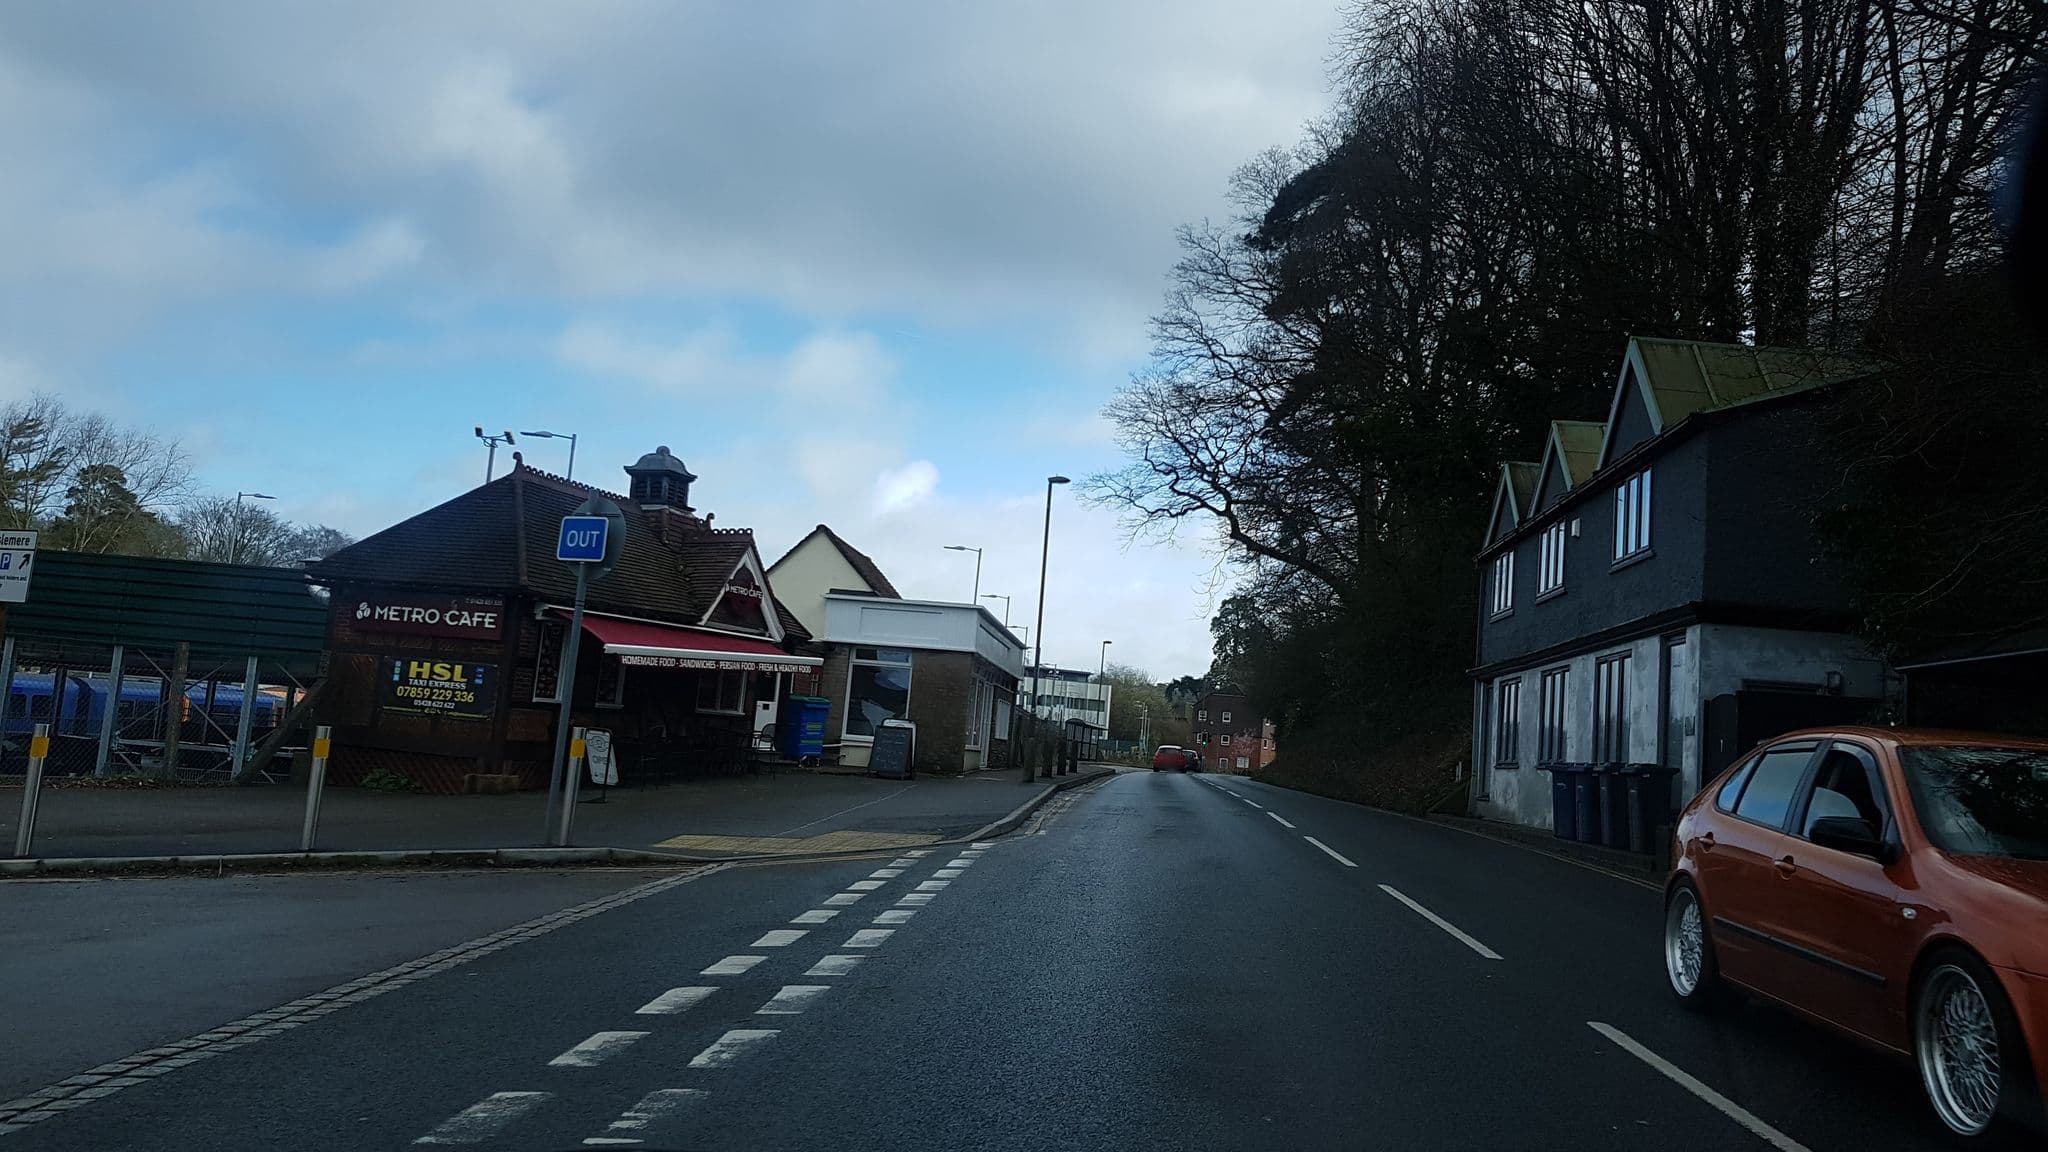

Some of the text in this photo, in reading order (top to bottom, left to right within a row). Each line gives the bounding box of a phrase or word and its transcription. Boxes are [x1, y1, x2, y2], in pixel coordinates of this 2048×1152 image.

[566, 530, 600, 547] OUT
[730, 585, 748, 596] METRO
[374, 605, 498, 628] METRO CAFE
[408, 661, 468, 683] HSL
[622, 655, 658, 665] HOMEMADE
[659, 657, 676, 667] FOOD
[679, 659, 716, 669] SANDWICHES
[719, 661, 741, 671] PERSIAN
[741, 662, 755, 671] FOOD
[758, 663, 774, 672] FRESH
[778, 664, 798, 673] HEALTHY
[798, 665, 812, 674] FOOD
[408, 678, 467, 690] TAXI EXPRESS
[396, 686, 475, 703] 07859 229 336
